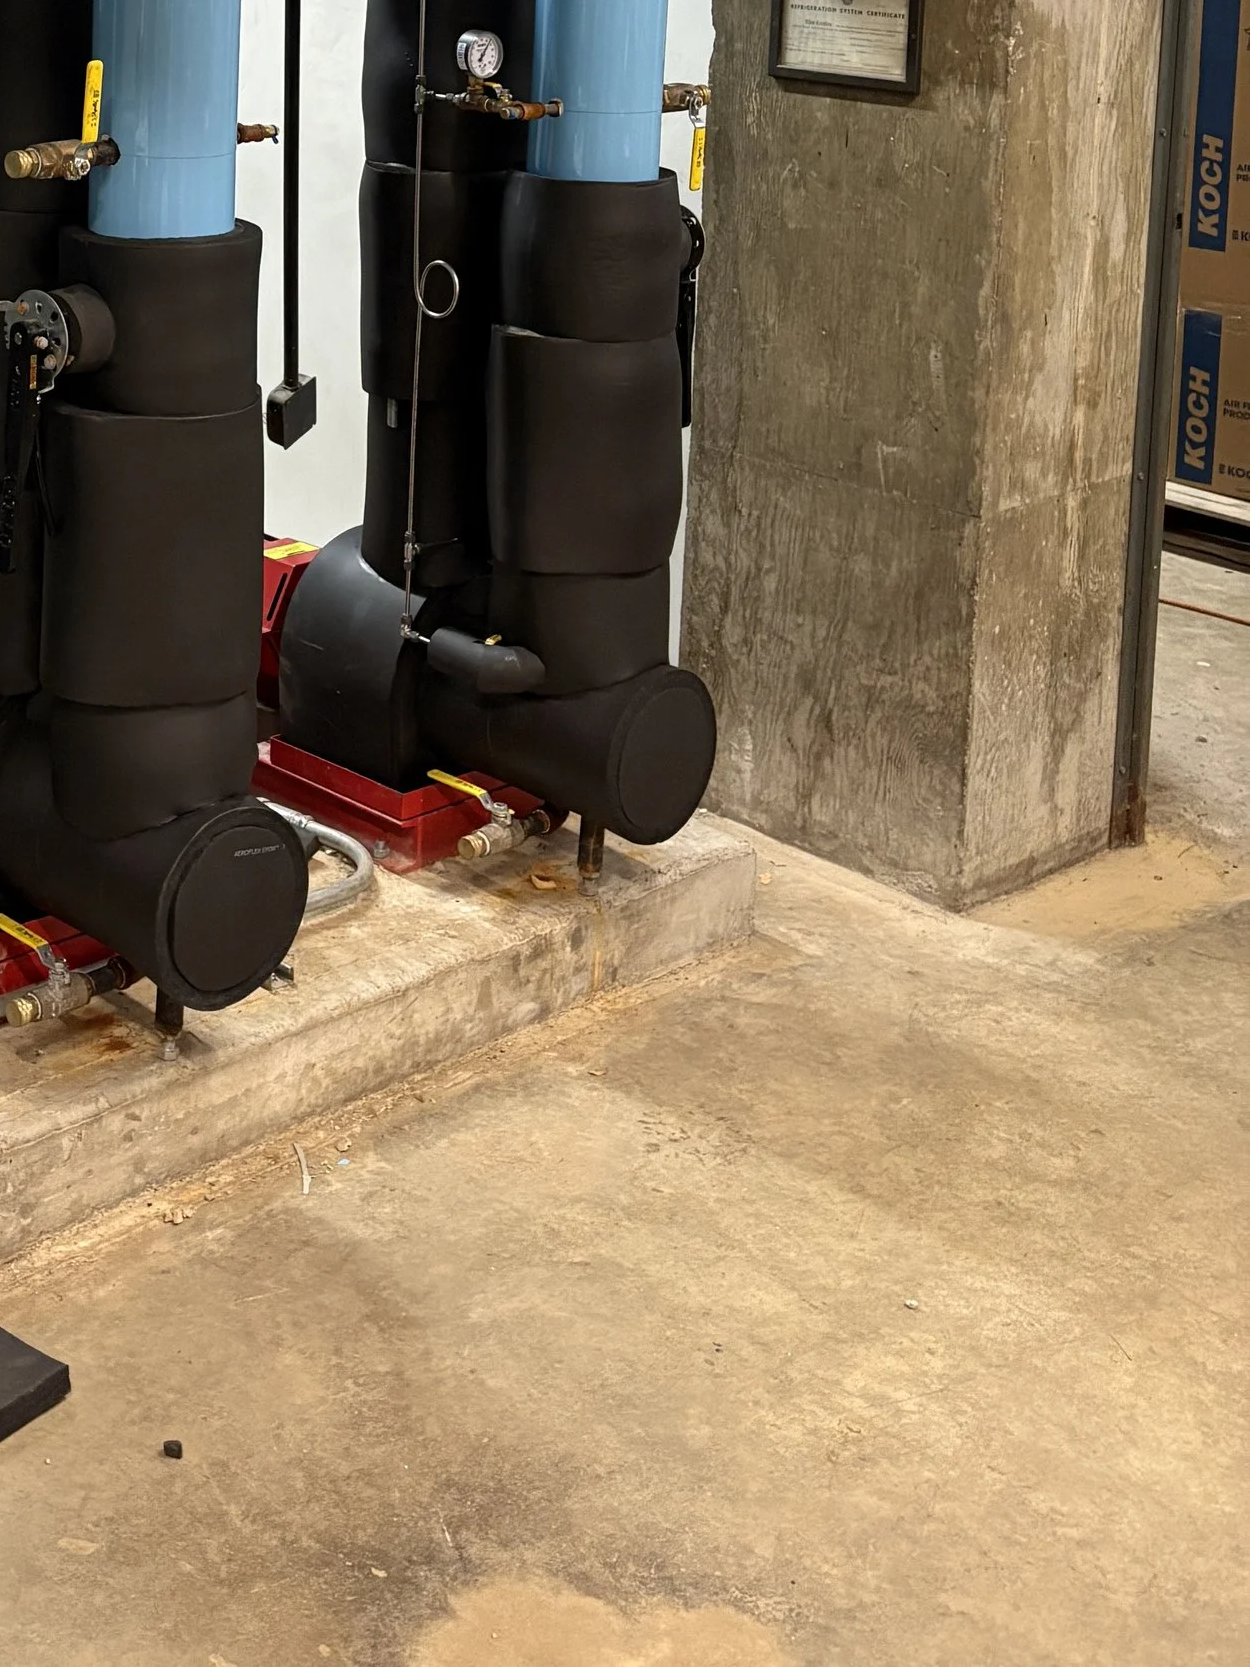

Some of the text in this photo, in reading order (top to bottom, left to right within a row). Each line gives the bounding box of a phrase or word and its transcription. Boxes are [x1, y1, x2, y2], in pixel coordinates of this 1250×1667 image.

[791, 3, 837, 12] REFRIGERATION
[866, 10, 905, 19] CERTIFICATE
[1197, 134, 1224, 237] KOCH
[1184, 366, 1210, 470] KOCH
